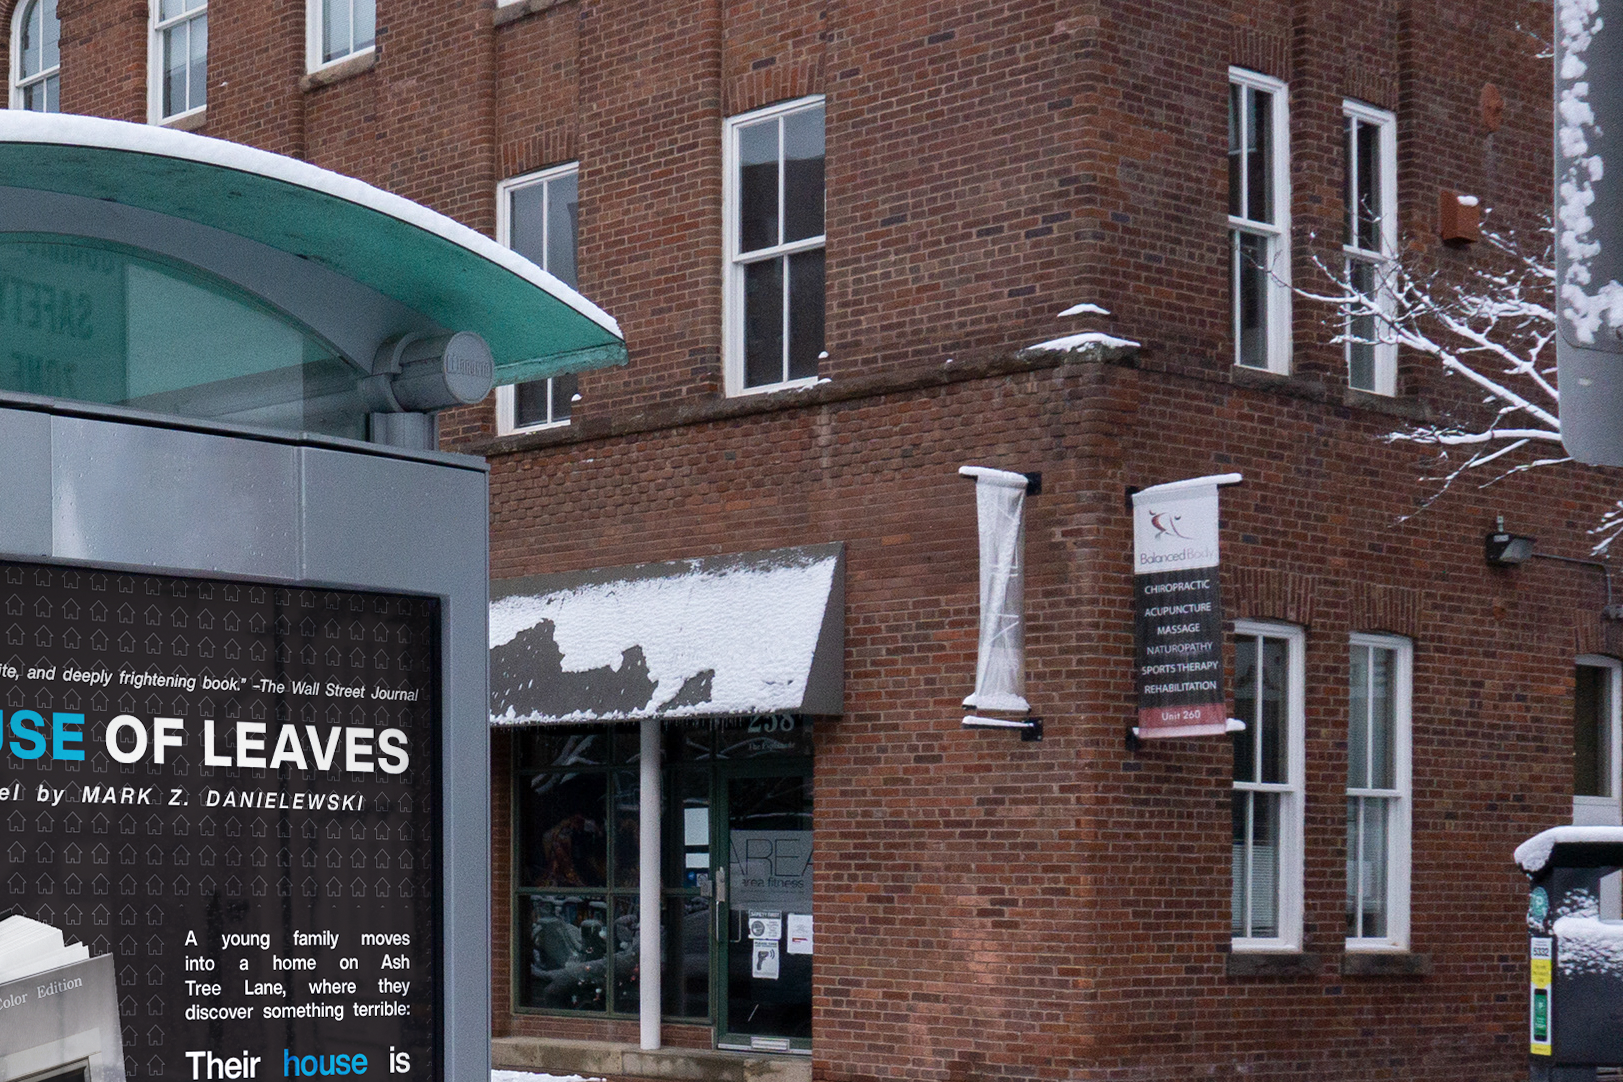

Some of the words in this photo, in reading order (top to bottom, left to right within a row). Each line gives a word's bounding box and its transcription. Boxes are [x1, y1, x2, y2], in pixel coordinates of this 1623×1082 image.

[1144, 579, 1211, 595] CHIROPRACTIC
[1144, 602, 1212, 617] ACUPUNCTURE
[1157, 622, 1201, 635] MASSAGE
[1146, 641, 1213, 655] NATUROPATHY
[1141, 663, 1176, 676] SPORTS
[1177, 660, 1219, 672] THERAPY
[27, 666, 56, 681] and
[62, 668, 112, 687] deeply
[119, 669, 196, 692] frightening
[292, 680, 320, 696] Wall
[325, 682, 365, 699] Street
[370, 686, 419, 702] Journal
[1144, 680, 1217, 694] REHABILITATION
[1161, 711, 1180, 721] Unit
[1183, 709, 1201, 720] 260
[105, 714, 184, 764] OF
[204, 719, 410, 774] LEAVES
[36, 784, 65, 806] by
[81, 786, 154, 805] MARK
[168, 789, 189, 806] Z.
[206, 790, 364, 811] DANIELEWSKI
[742, 878, 765, 889] area
[768, 876, 804, 889] fitness
[184, 930, 198, 946] A
[222, 933, 270, 950] young
[293, 930, 339, 949] family
[361, 932, 411, 946] moves
[1533, 947, 1549, 957] 5332
[185, 955, 215, 971] into
[239, 959, 249, 971] a
[273, 954, 316, 971] home
[339, 957, 359, 970] on
[381, 954, 411, 970] Ash
[36, 976, 83, 999] Edition
[185, 980, 222, 996] Tree
[244, 979, 286, 998] Lane,
[308, 979, 357, 994] where
[378, 978, 411, 997] they
[185, 1004, 254, 1021] discover
[263, 1002, 344, 1021] something
[353, 1001, 411, 1017] terrible:
[185, 1050, 261, 1080] Their
[283, 1048, 368, 1077] house
[389, 1046, 411, 1074] is
